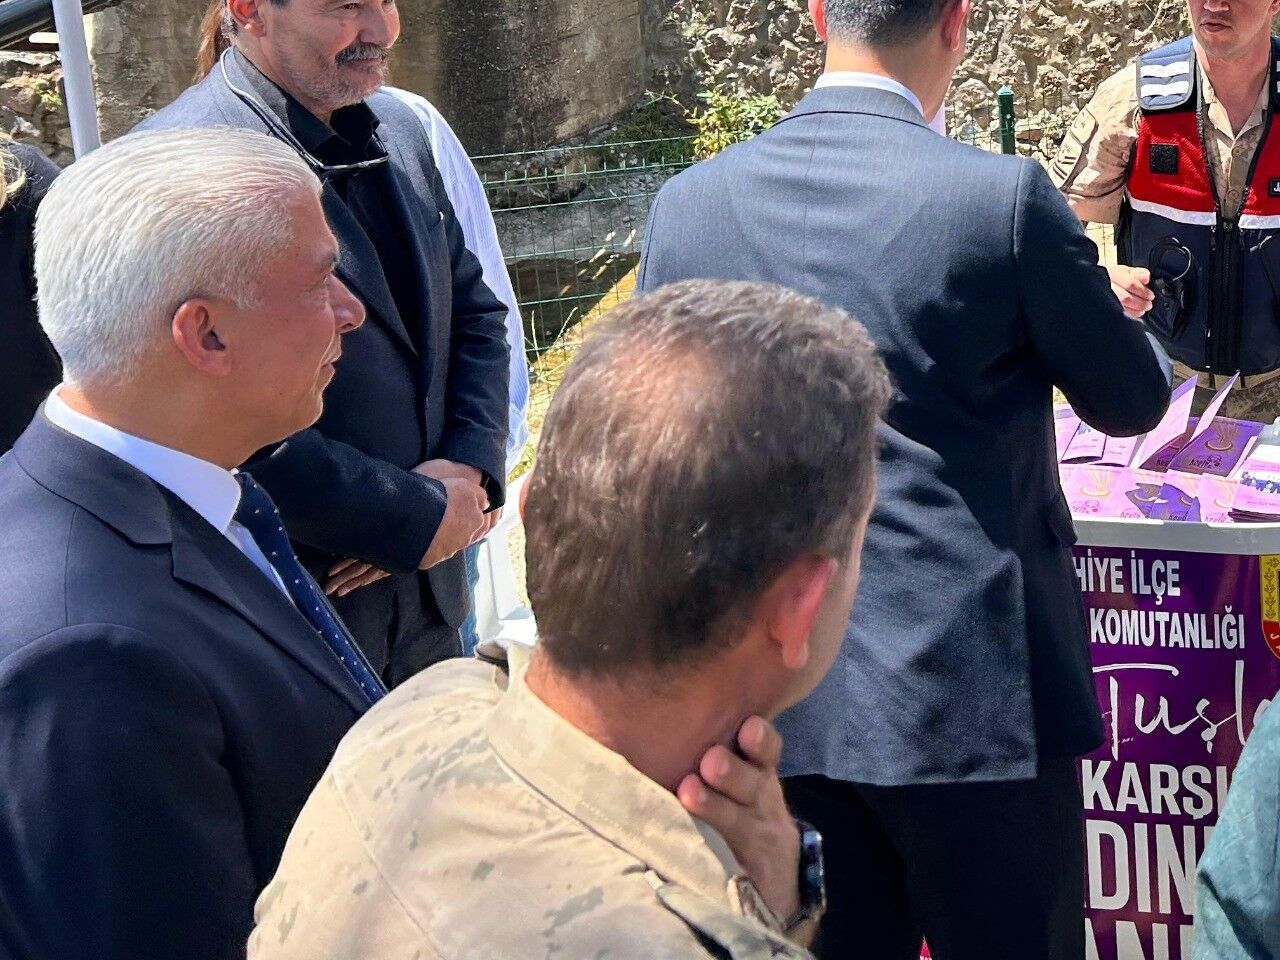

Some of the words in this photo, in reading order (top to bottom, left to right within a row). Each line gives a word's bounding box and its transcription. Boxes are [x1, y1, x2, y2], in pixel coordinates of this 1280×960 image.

[1131, 550, 1181, 605] İLÇE
[1089, 605, 1245, 649] KOMUTANLIĞI
[1085, 819, 1216, 916] DIN
